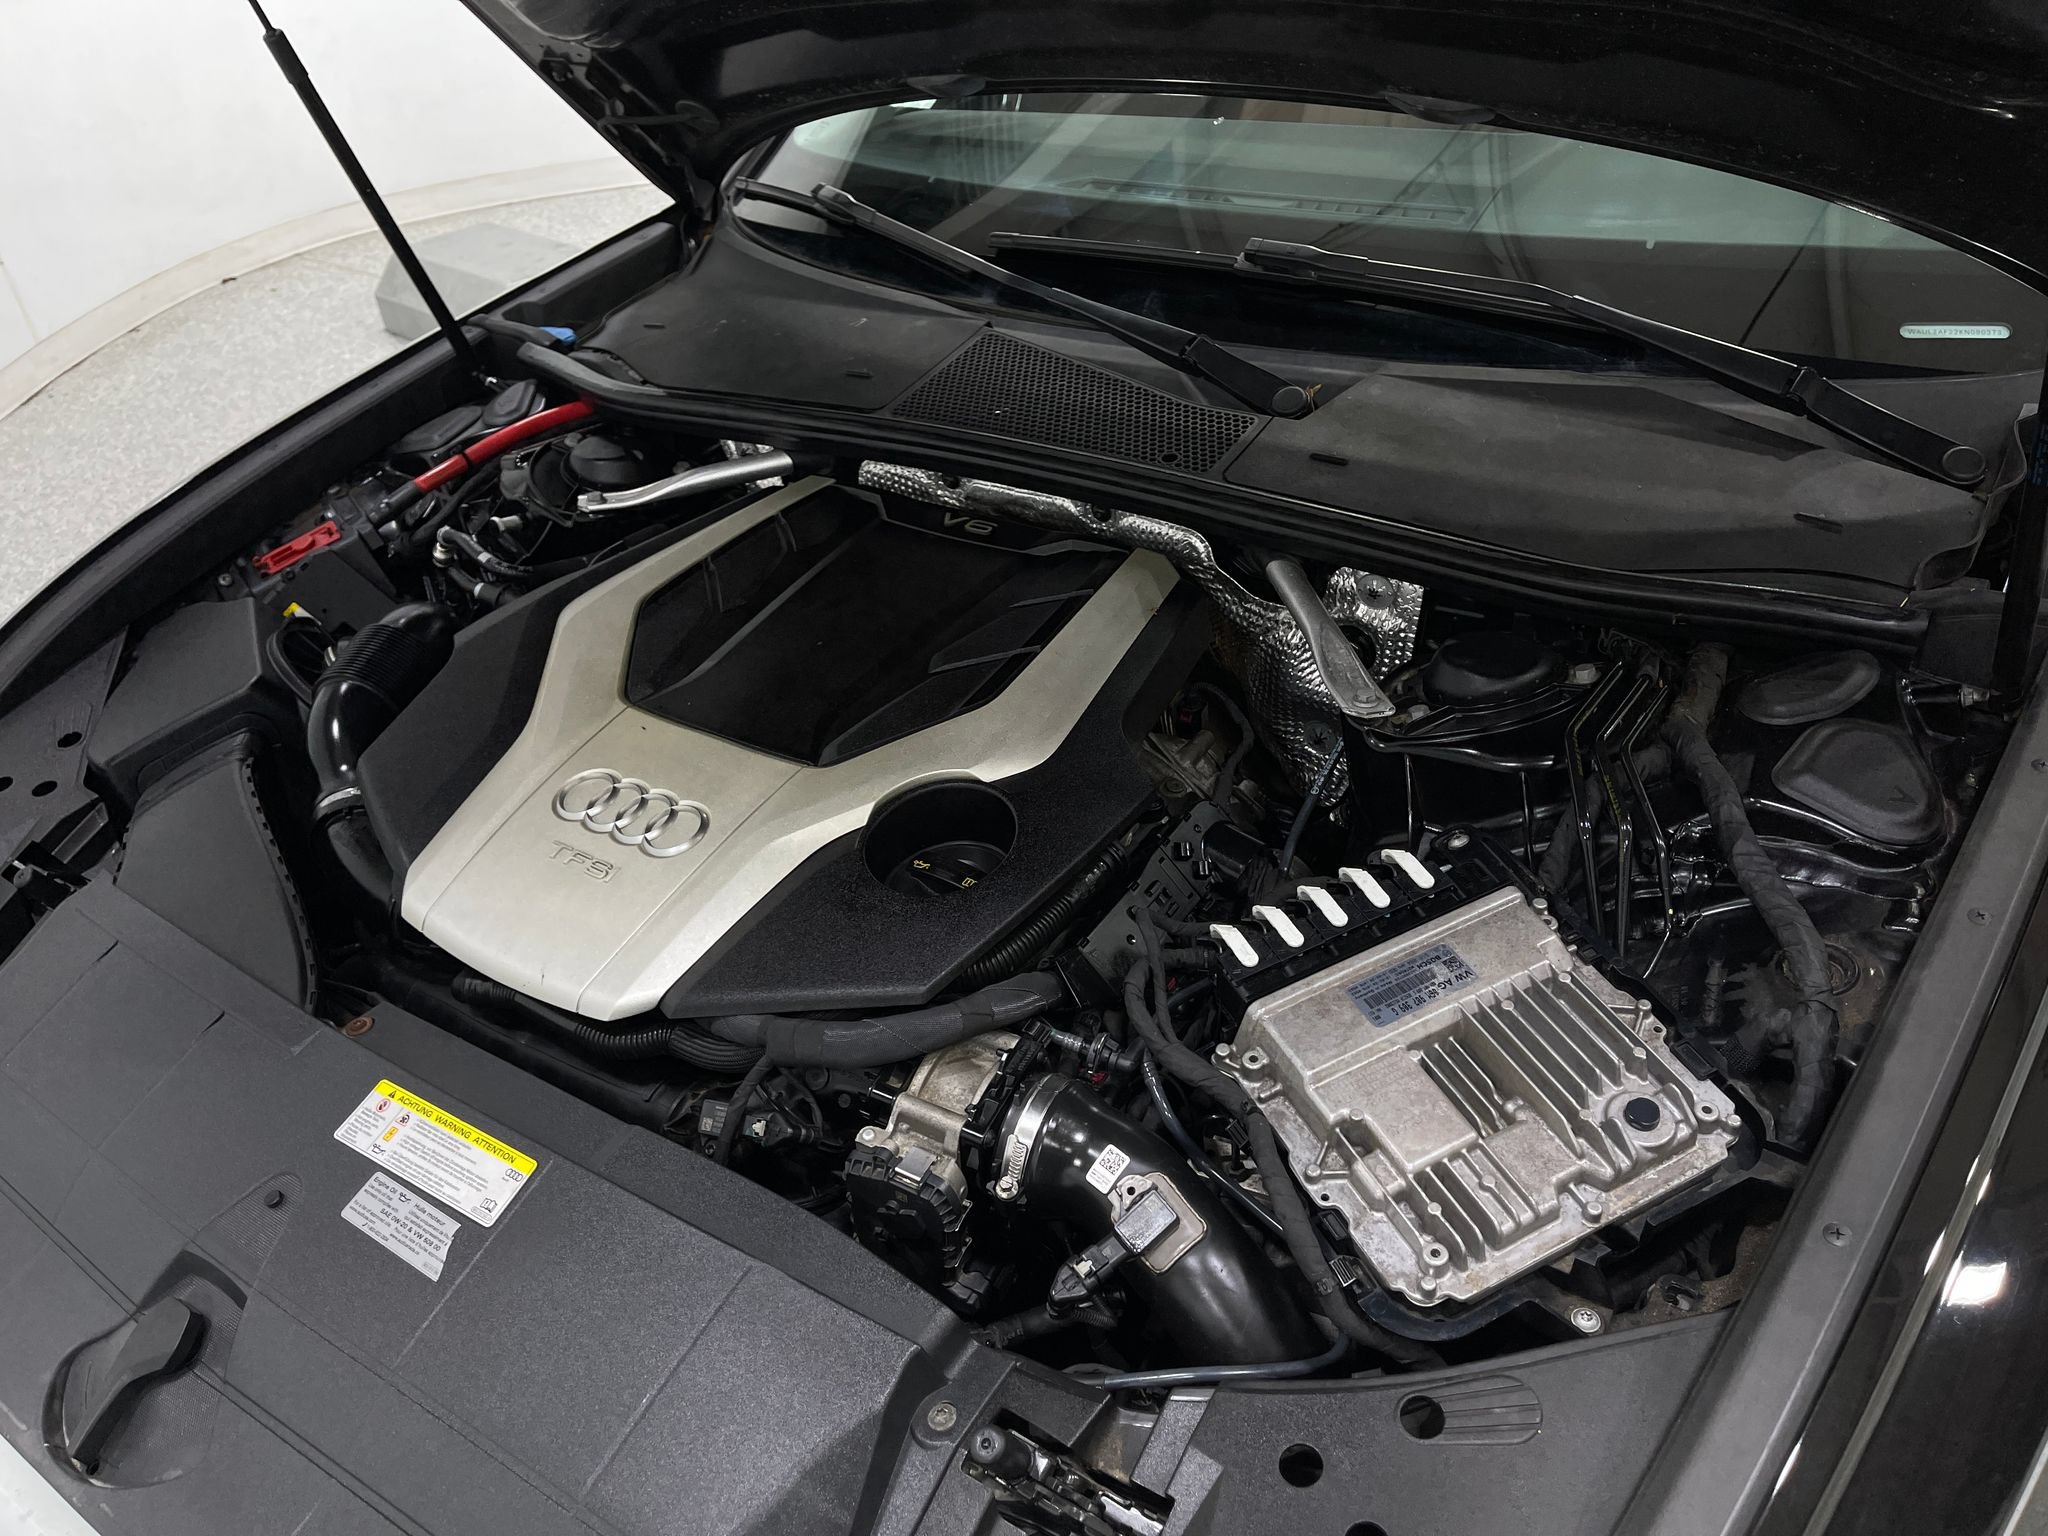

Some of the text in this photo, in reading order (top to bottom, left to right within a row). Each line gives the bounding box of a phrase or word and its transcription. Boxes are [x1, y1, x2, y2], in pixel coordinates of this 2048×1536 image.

[944, 512, 998, 535] V6
[549, 840, 621, 883] TFSI
[1416, 955, 1442, 969] BOSCH
[1438, 978, 1453, 990] AG
[1455, 970, 1473, 982] VW
[399, 1095, 433, 1119] ACHTUNG
[434, 1115, 472, 1140] WARNING
[473, 1136, 517, 1165] ATTENTION
[374, 1177, 390, 1190] Engine
[414, 1204, 446, 1226] Huile moteur
[380, 1208, 392, 1218] SAE
[391, 1216, 408, 1229] 0W-20
[414, 1230, 424, 1239] VW
[423, 1238, 434, 1247] 508
